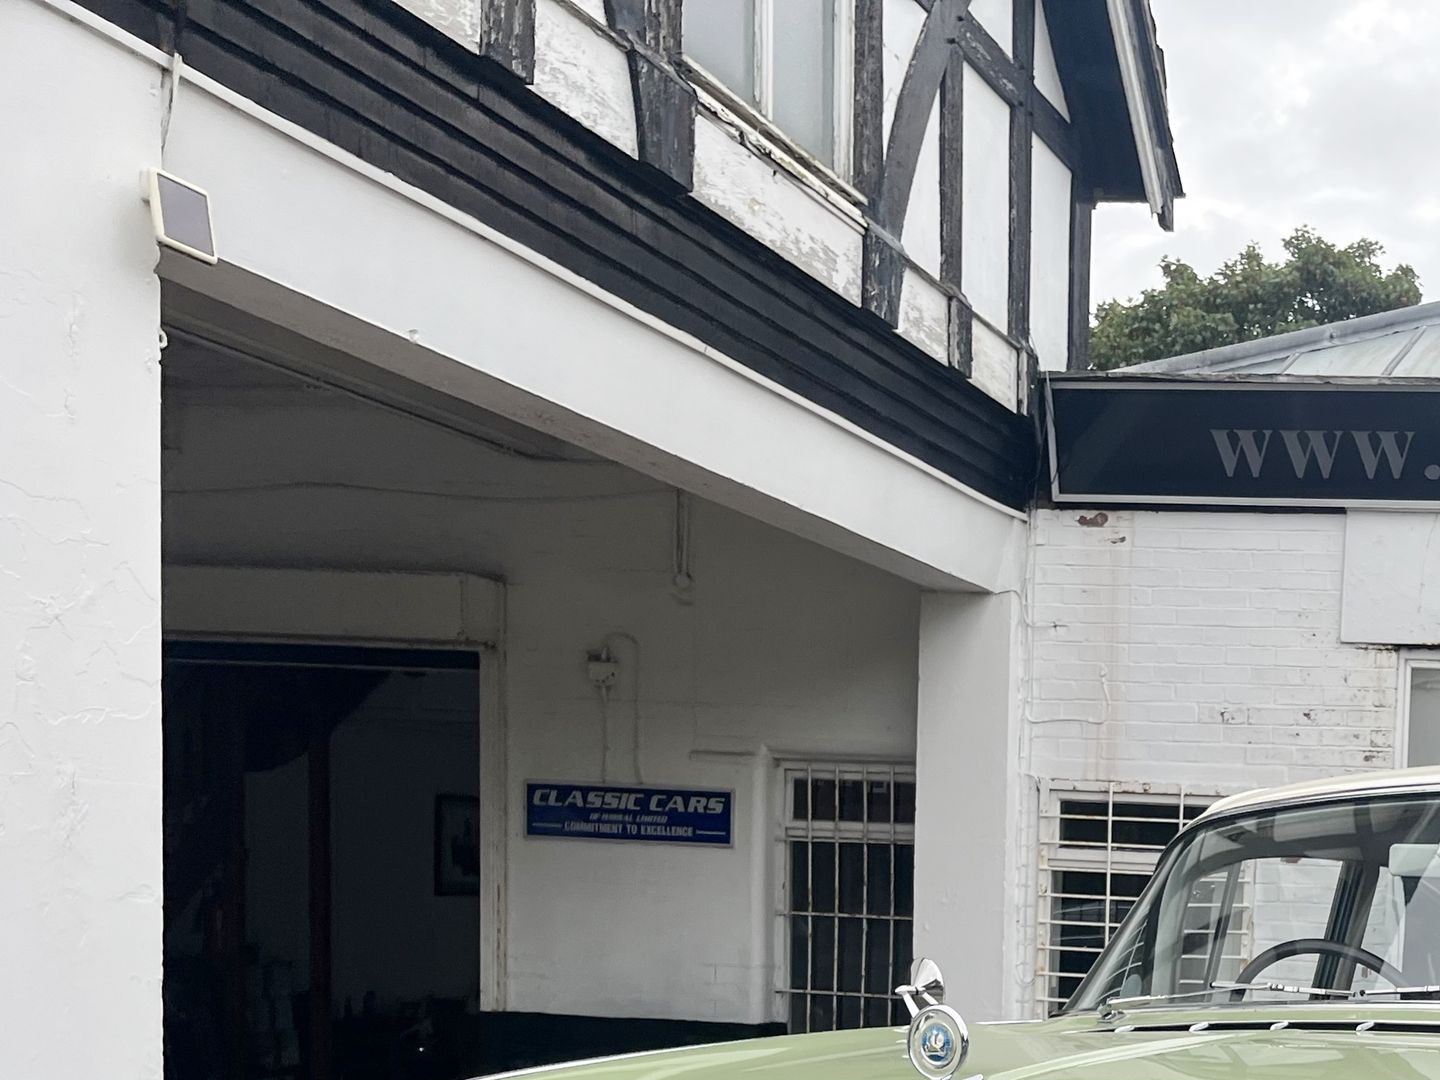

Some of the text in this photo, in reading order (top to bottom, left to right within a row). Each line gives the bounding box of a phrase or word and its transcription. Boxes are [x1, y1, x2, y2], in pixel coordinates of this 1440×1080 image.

[532, 788, 726, 814] CLASSIC CARS
[564, 821, 694, 838] COMMITMENT TO EXCELLENCE
